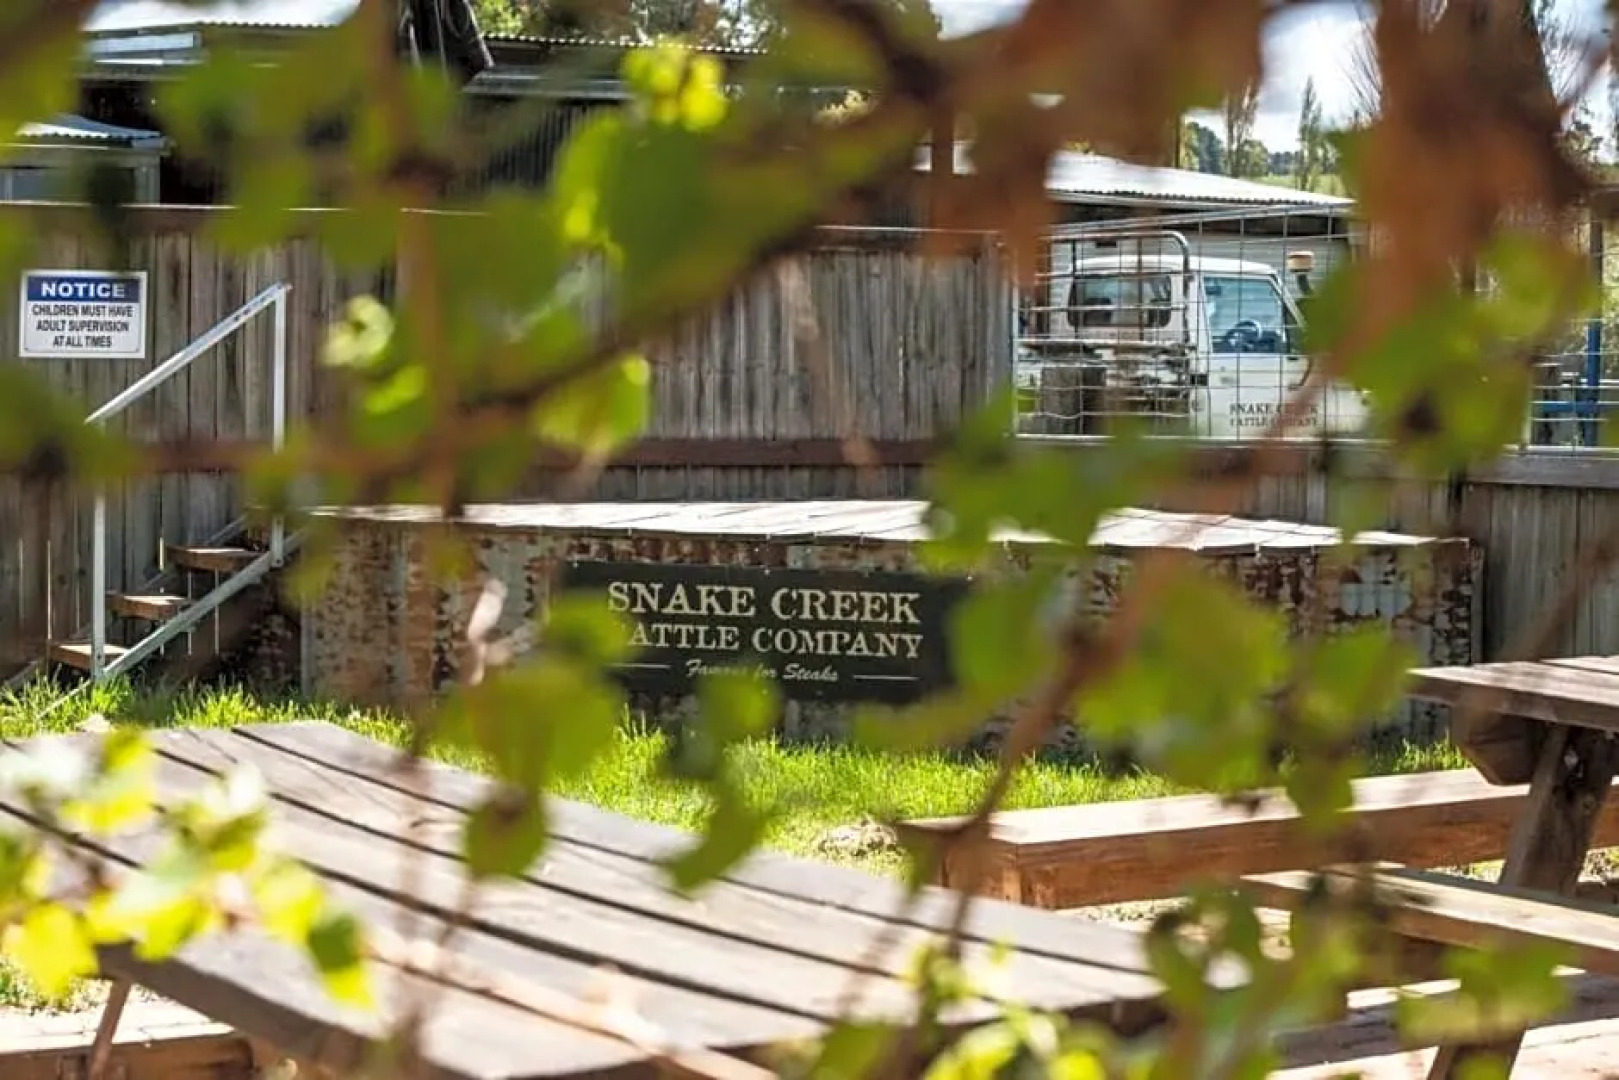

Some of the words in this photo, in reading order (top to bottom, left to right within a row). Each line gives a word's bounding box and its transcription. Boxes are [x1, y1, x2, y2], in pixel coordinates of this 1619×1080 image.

[41, 282, 125, 298] NOTICE
[32, 304, 79, 316] CHILDREN
[81, 304, 106, 316] MUST
[108, 305, 133, 318] HAVE
[36, 320, 66, 331] ADULT
[68, 320, 129, 332] SUPERVISION
[53, 335, 63, 347] AT
[65, 335, 83, 347] ALL
[85, 335, 112, 348] TIMES
[607, 581, 756, 617] SNAKE
[771, 587, 921, 625] CREEK
[619, 622, 740, 651] ATTLE
[751, 628, 923, 659] COMPANY
[782, 663, 839, 682] Steaks
